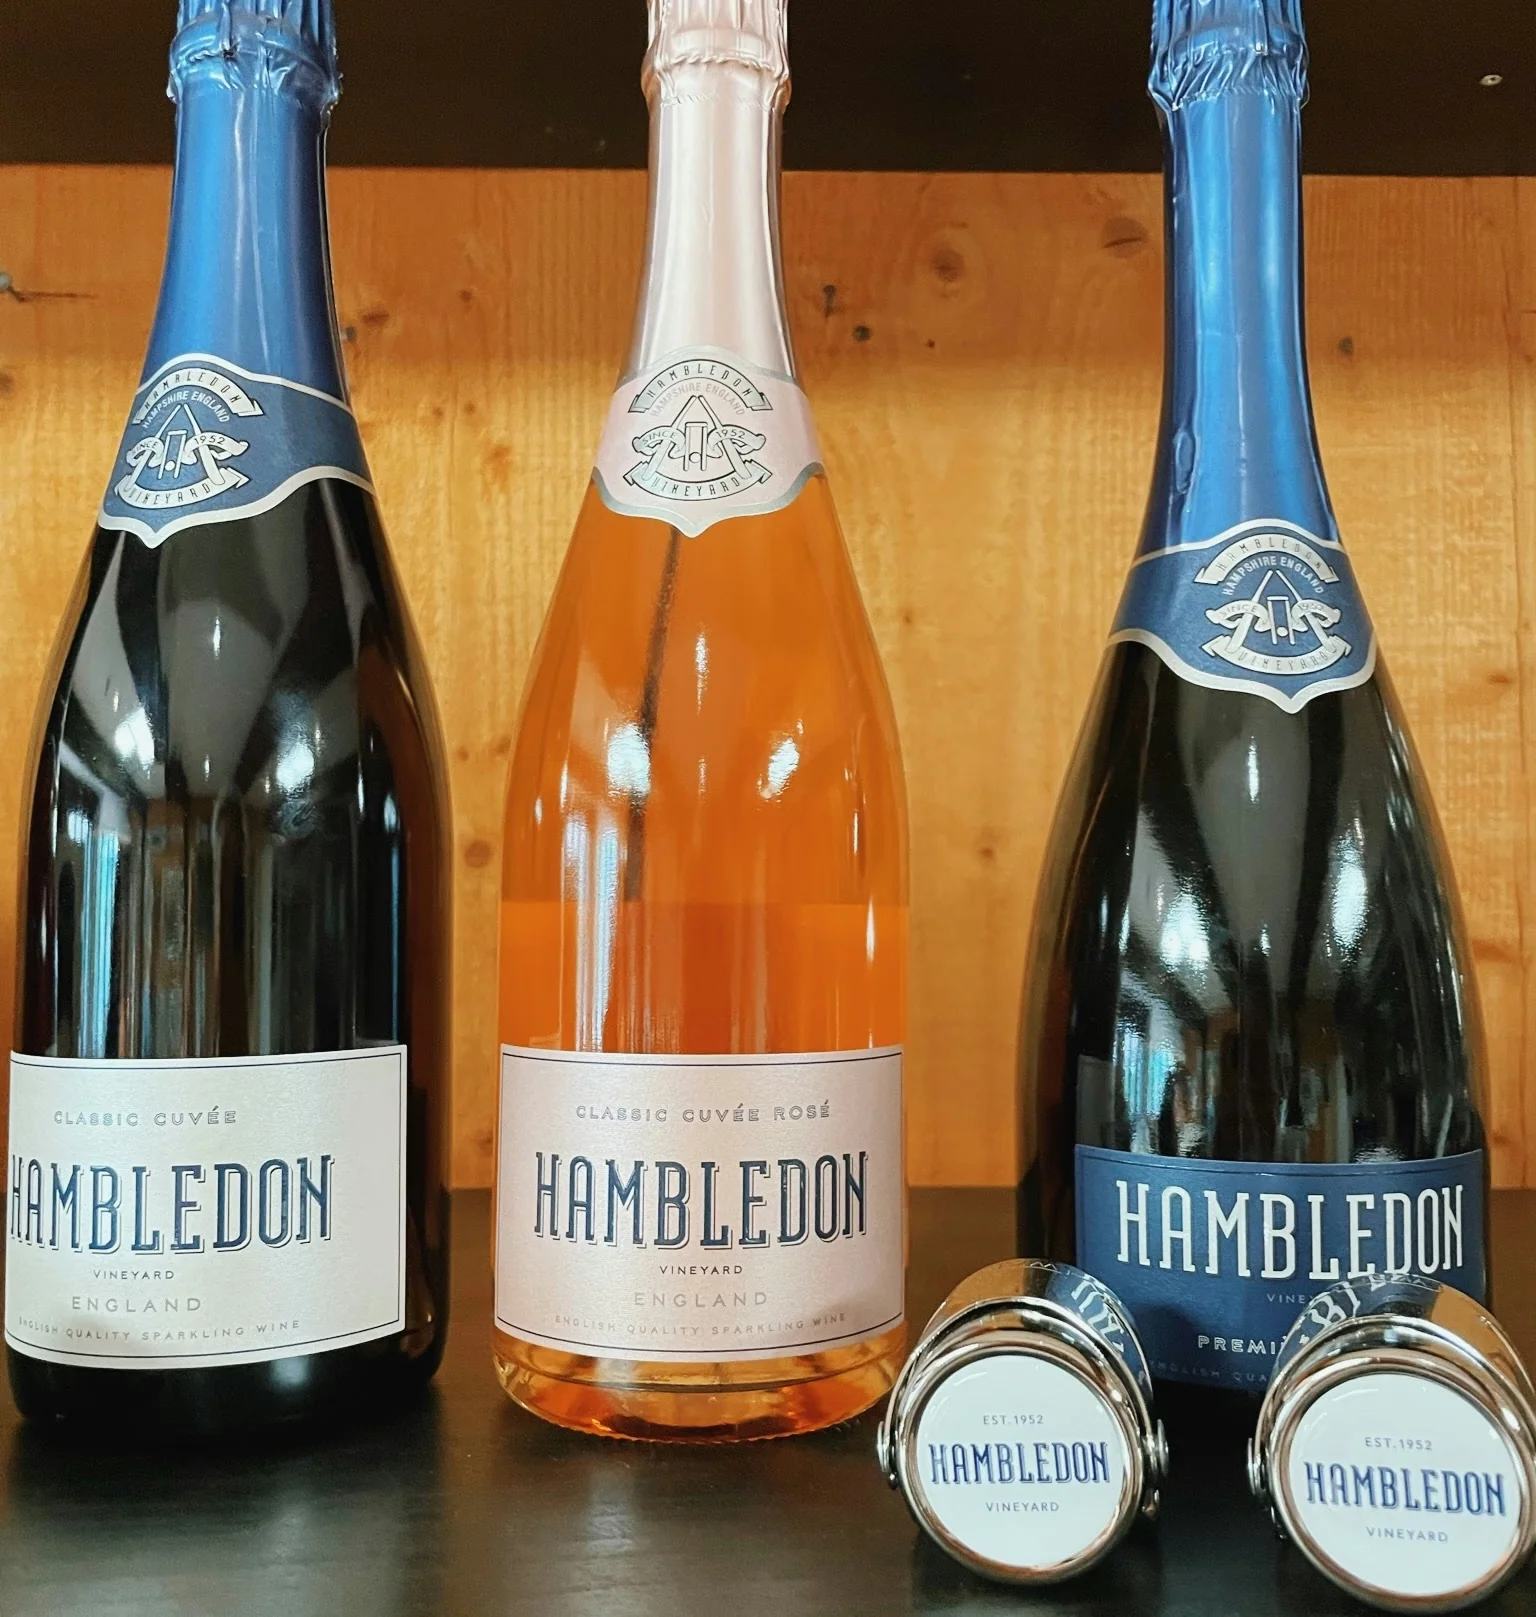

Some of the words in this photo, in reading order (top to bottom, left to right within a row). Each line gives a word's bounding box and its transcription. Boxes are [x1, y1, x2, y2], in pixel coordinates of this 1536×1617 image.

[646, 363, 753, 398] HAMBLEDON
[142, 391, 190, 428] HAMPSHIRE
[191, 391, 230, 422] ENGLAND
[651, 382, 702, 416] HAMPSHIRE
[706, 384, 745, 416] ENGLAND
[194, 435, 225, 445] 1952
[642, 431, 676, 445] SINCE
[716, 429, 745, 440] 1952
[128, 483, 210, 505] VINEYARD
[651, 476, 740, 496] VINEYARD
[1222, 556, 1277, 596] HAMPSHIRE
[1280, 556, 1324, 594] ENGLAND
[1221, 604, 1257, 617] SINCE
[53, 1110, 139, 1127] CLASSIC
[154, 1105, 237, 1126] CUVÉE
[576, 1105, 667, 1123] CLASSIC
[682, 1103, 759, 1123] CUVÉE
[774, 1100, 830, 1121] ROSÉ
[10, 1154, 335, 1255] HAMBLEDON
[534, 1151, 868, 1250] HAMBLEDON
[1115, 1180, 1463, 1280] HAMBLEDON
[93, 1269, 175, 1280] VINEYARD
[659, 1264, 743, 1275] VINEYARD
[72, 1296, 201, 1313] ENGLAND
[634, 1291, 768, 1307] ENGLAND
[66, 1328, 130, 1341] QUALITY
[142, 1327, 245, 1341] SPARKLING
[256, 1320, 300, 1334] WINE
[555, 1315, 616, 1332] ENGLISH
[627, 1324, 700, 1336] QUALITY
[712, 1320, 805, 1336] SPARKLING
[813, 1312, 846, 1325] WINE
[1198, 1335, 1287, 1355] PREMI
[983, 1414, 1044, 1425] EST.1952
[1365, 1436, 1433, 1451] EST.1952
[928, 1441, 1110, 1485] HAMBLEDON
[1304, 1462, 1507, 1517] HAMBLEDON
[986, 1502, 1059, 1513] VINEYARD
[1366, 1526, 1448, 1543] VINEYARD
